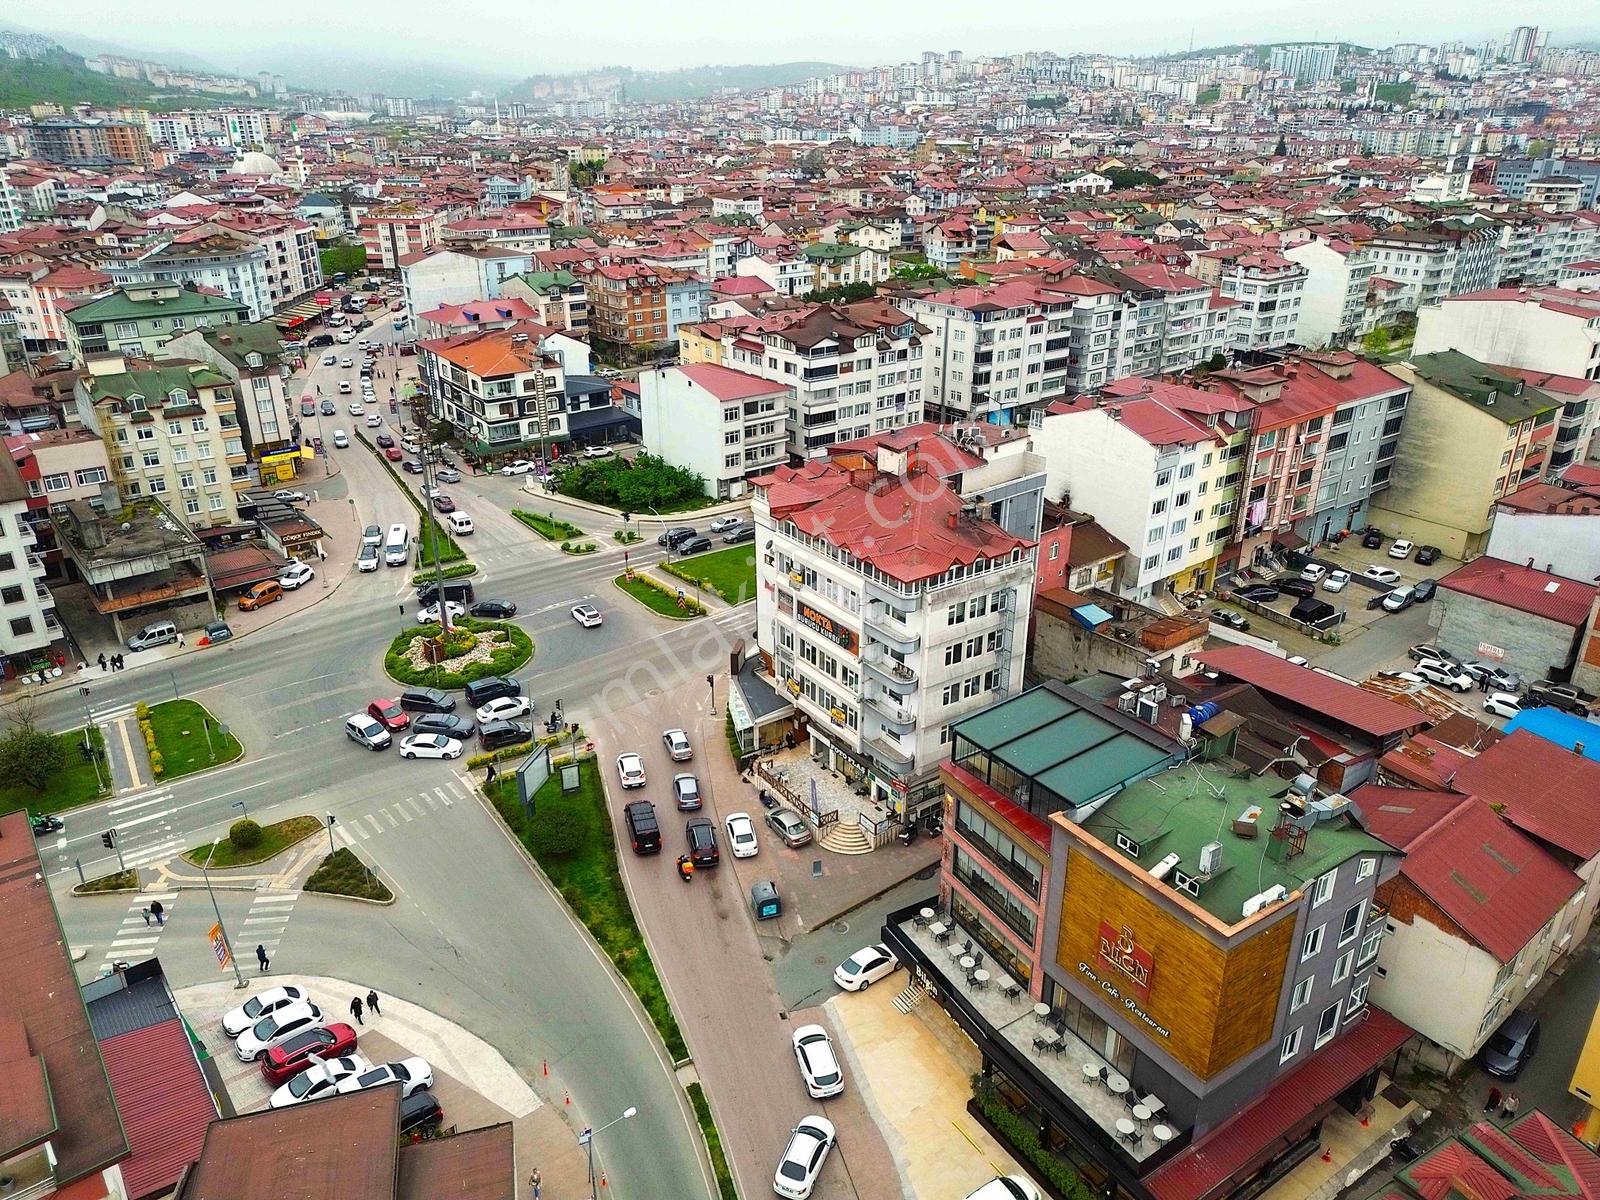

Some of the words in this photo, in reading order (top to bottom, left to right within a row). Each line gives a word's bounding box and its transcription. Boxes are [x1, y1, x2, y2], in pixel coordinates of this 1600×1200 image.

[803, 606, 833, 632] NOKTA
[830, 743, 848, 760] FOTO
[916, 964, 938, 996] Bilgin
[1101, 981, 1120, 998] Cafe
